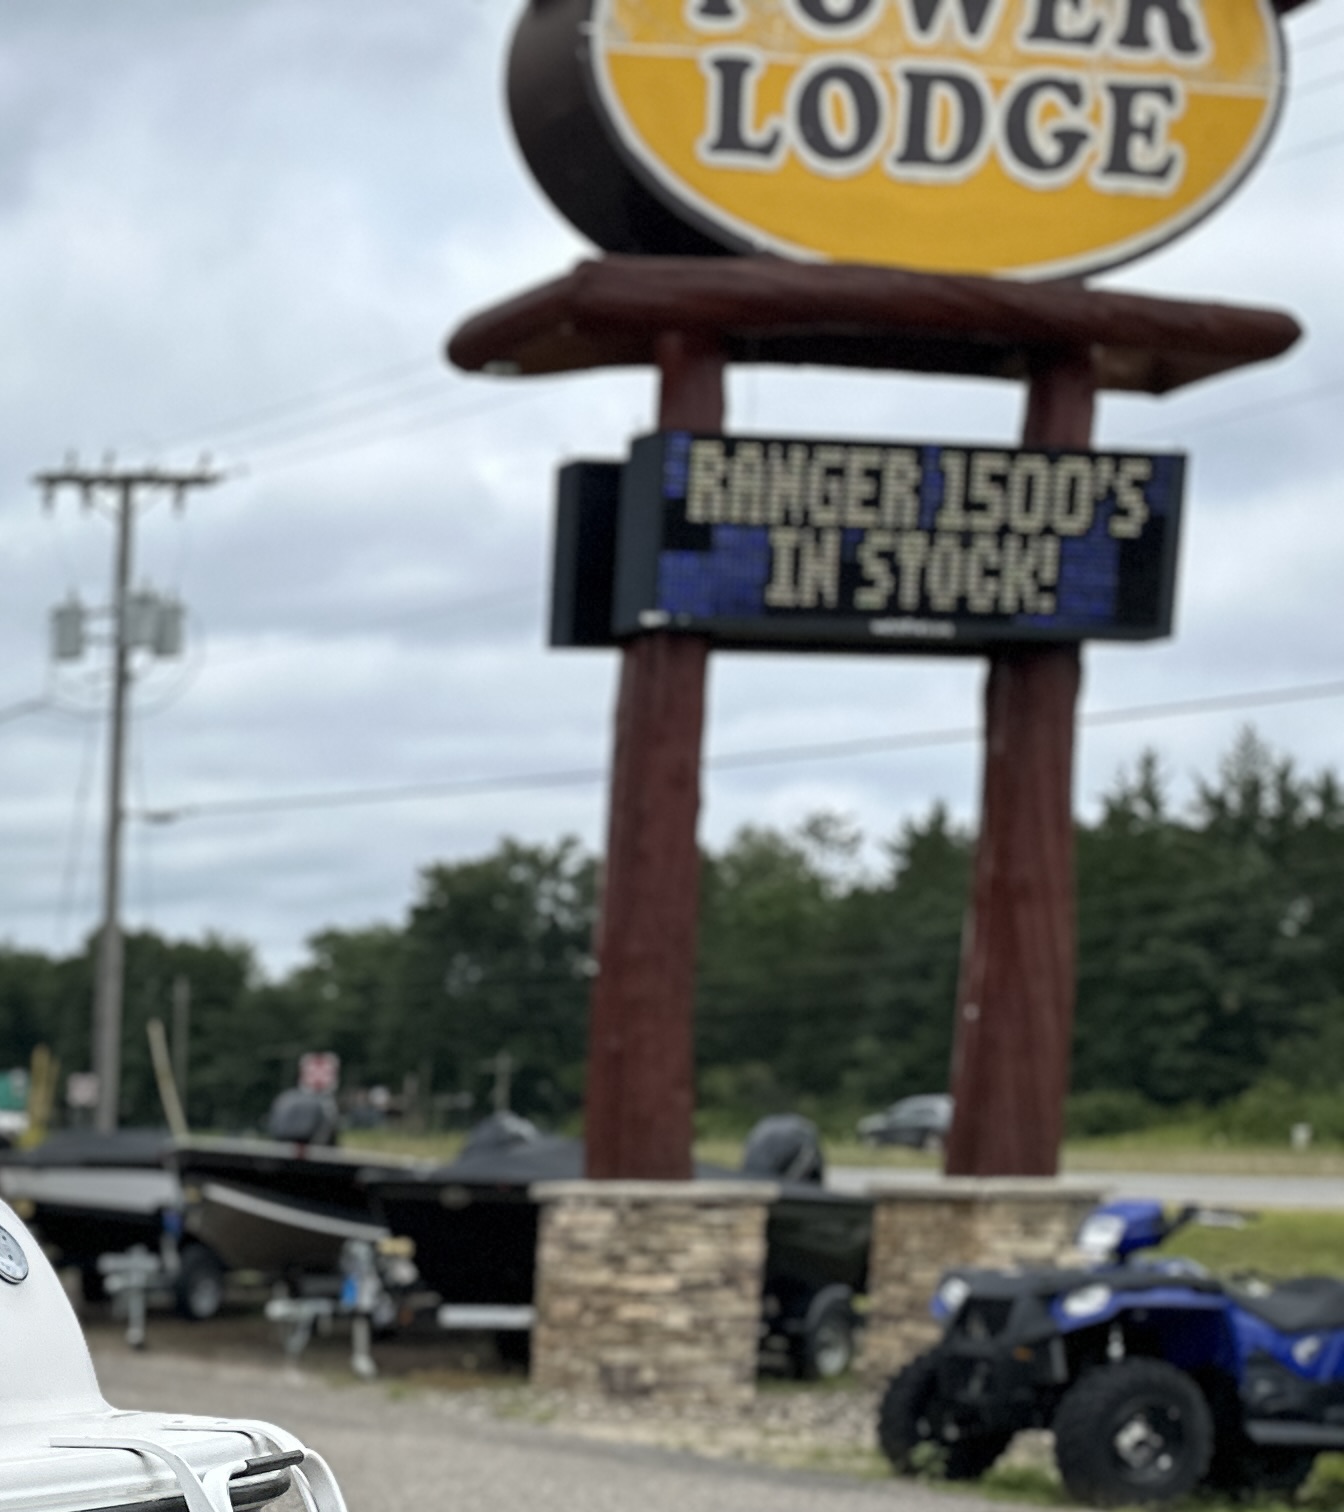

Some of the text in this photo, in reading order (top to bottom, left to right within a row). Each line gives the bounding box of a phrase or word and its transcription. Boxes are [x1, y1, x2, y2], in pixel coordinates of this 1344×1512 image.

[704, 54, 1180, 183] LODGE
[686, 439, 1153, 539] RANGER 1500'S
[765, 526, 1062, 615] IN STOCK!
